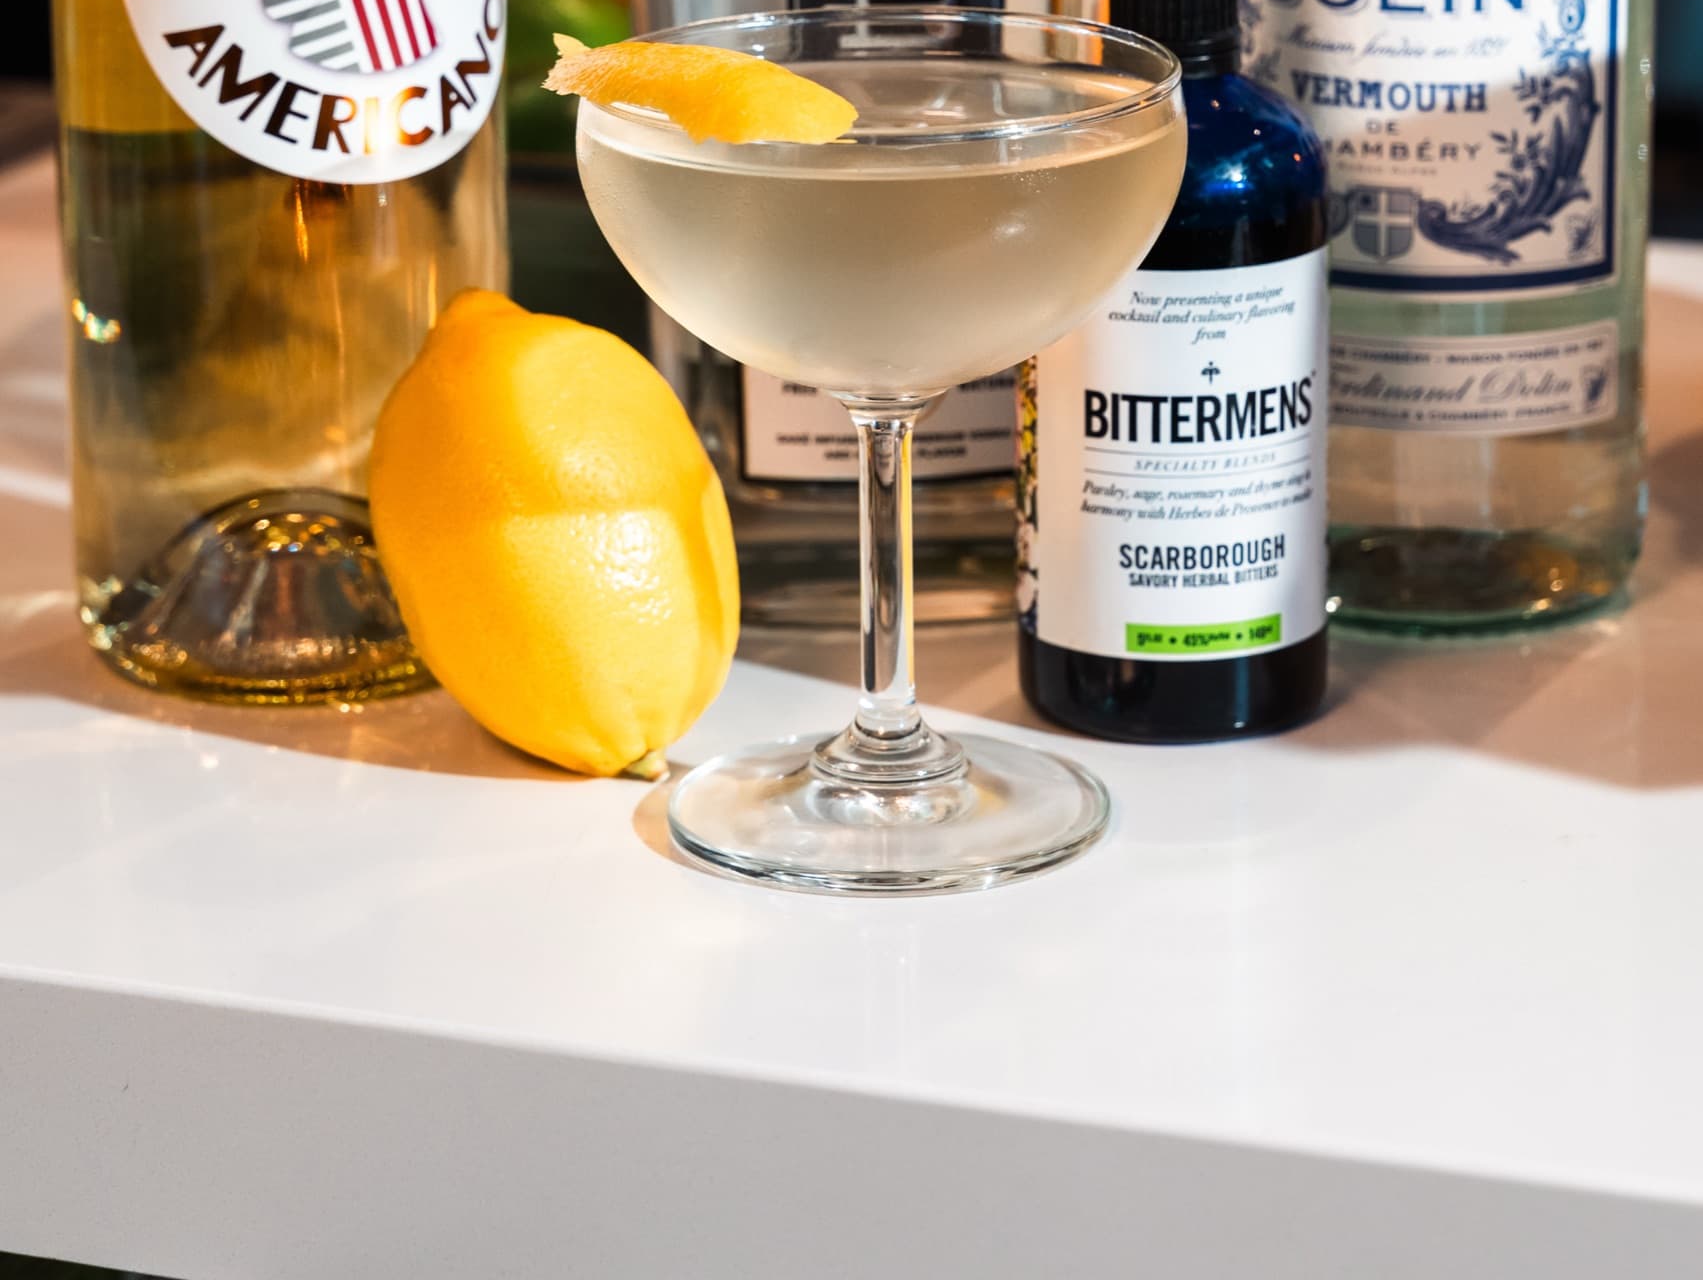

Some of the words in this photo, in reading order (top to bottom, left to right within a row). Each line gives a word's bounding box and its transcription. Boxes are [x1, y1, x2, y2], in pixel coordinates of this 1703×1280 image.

[1290, 70, 1488, 113] VERMOUTH
[1366, 120, 1400, 136] DE
[1163, 291, 1231, 309] presenting
[1108, 309, 1162, 324] cocktail
[1162, 310, 1191, 324] and
[1190, 326, 1227, 345] from
[1084, 376, 1312, 444] BITTERMENS
[1119, 534, 1286, 571] SCARBOROUGH
[1128, 572, 1178, 588] SAVORY
[1182, 572, 1230, 588] HERBAL
[1234, 564, 1279, 585] BITTERS
